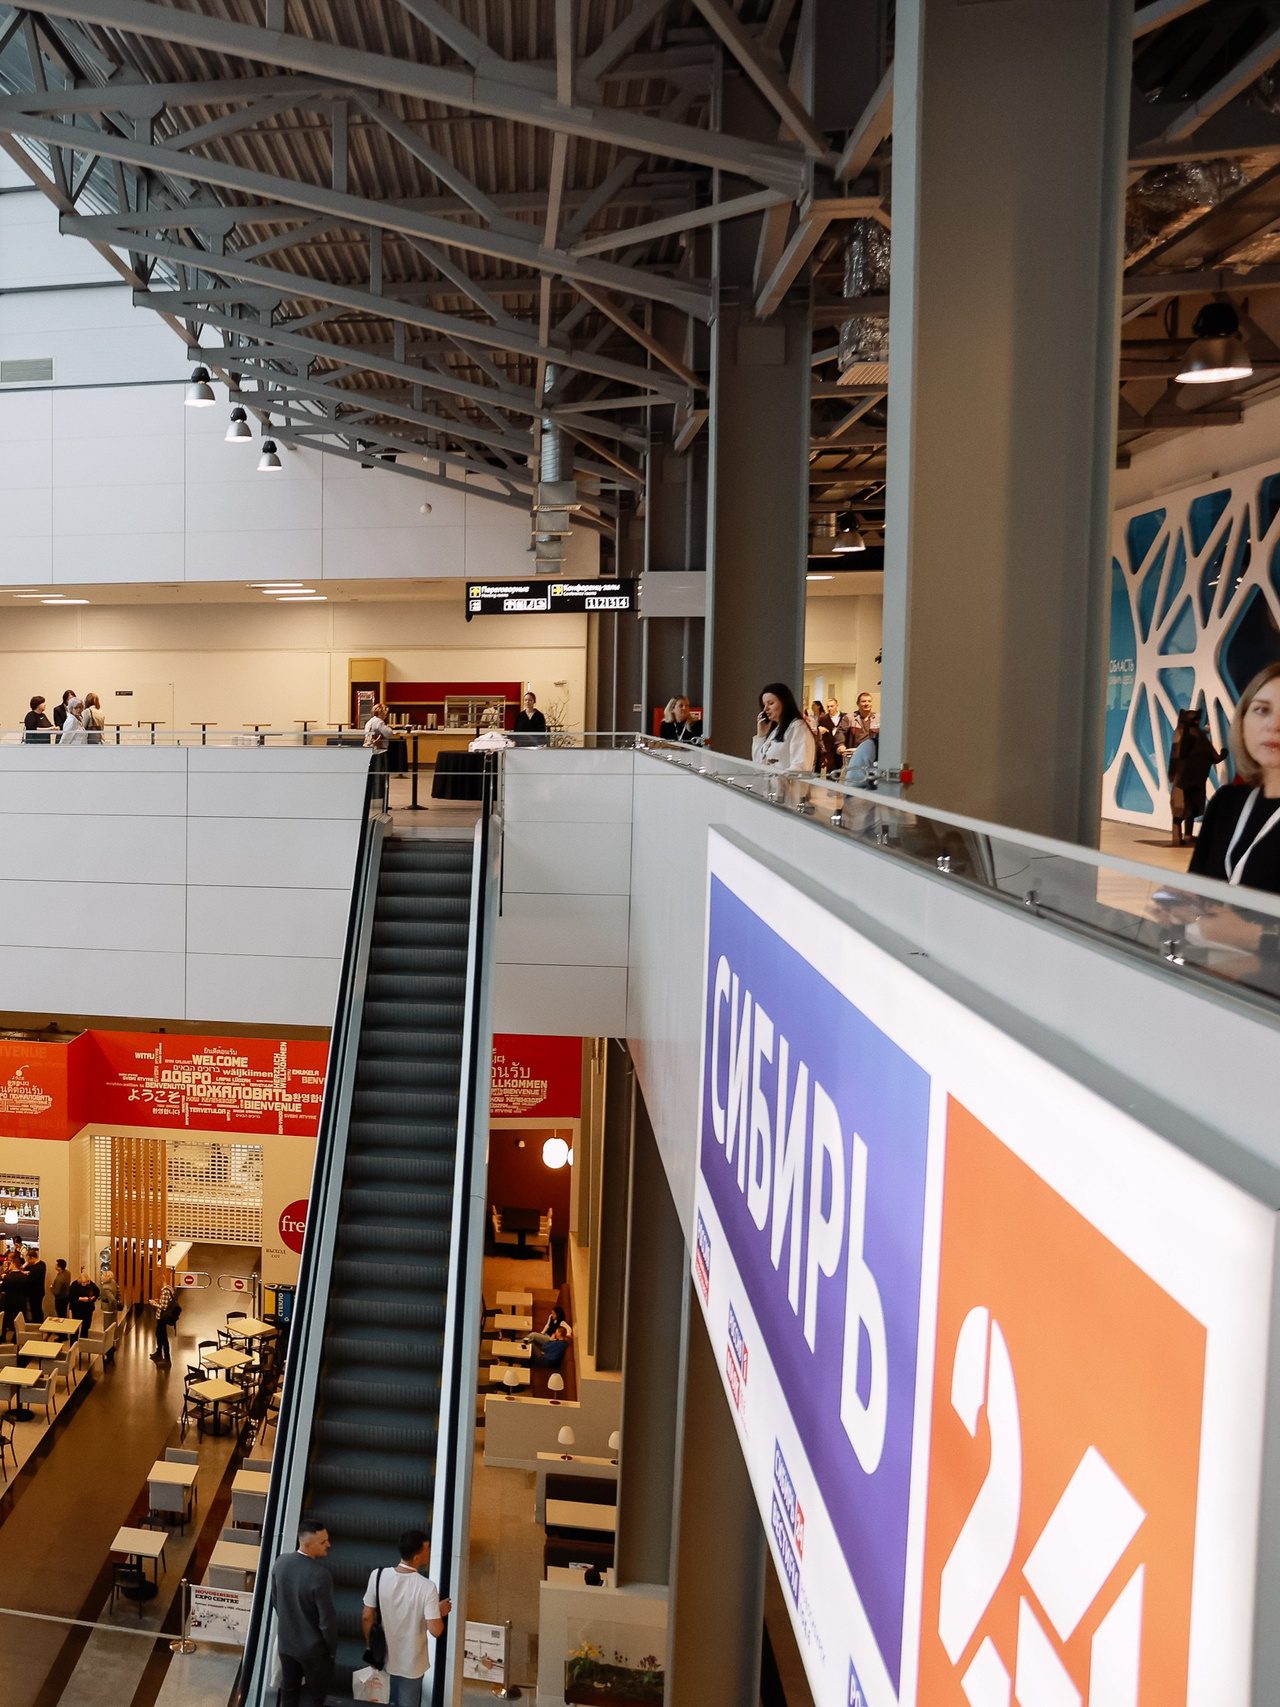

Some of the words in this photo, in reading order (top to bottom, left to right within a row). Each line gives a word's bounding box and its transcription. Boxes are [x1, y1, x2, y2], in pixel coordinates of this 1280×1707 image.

[192, 1054, 248, 1068] WELCOME
[161, 1069, 211, 1085] ДОБРО
[492, 1079, 548, 1088] LLKOMMEN
[145, 1082, 185, 1090] BENVENUTO
[187, 1084, 293, 1102] ПОЖАЛОВАТЬ
[128, 1088, 180, 1104] ようこそ
[244, 1100, 302, 1113] BIENVENUE
[711, 955, 889, 1475] СИБИРЬ
[281, 1215, 306, 1233] fre
